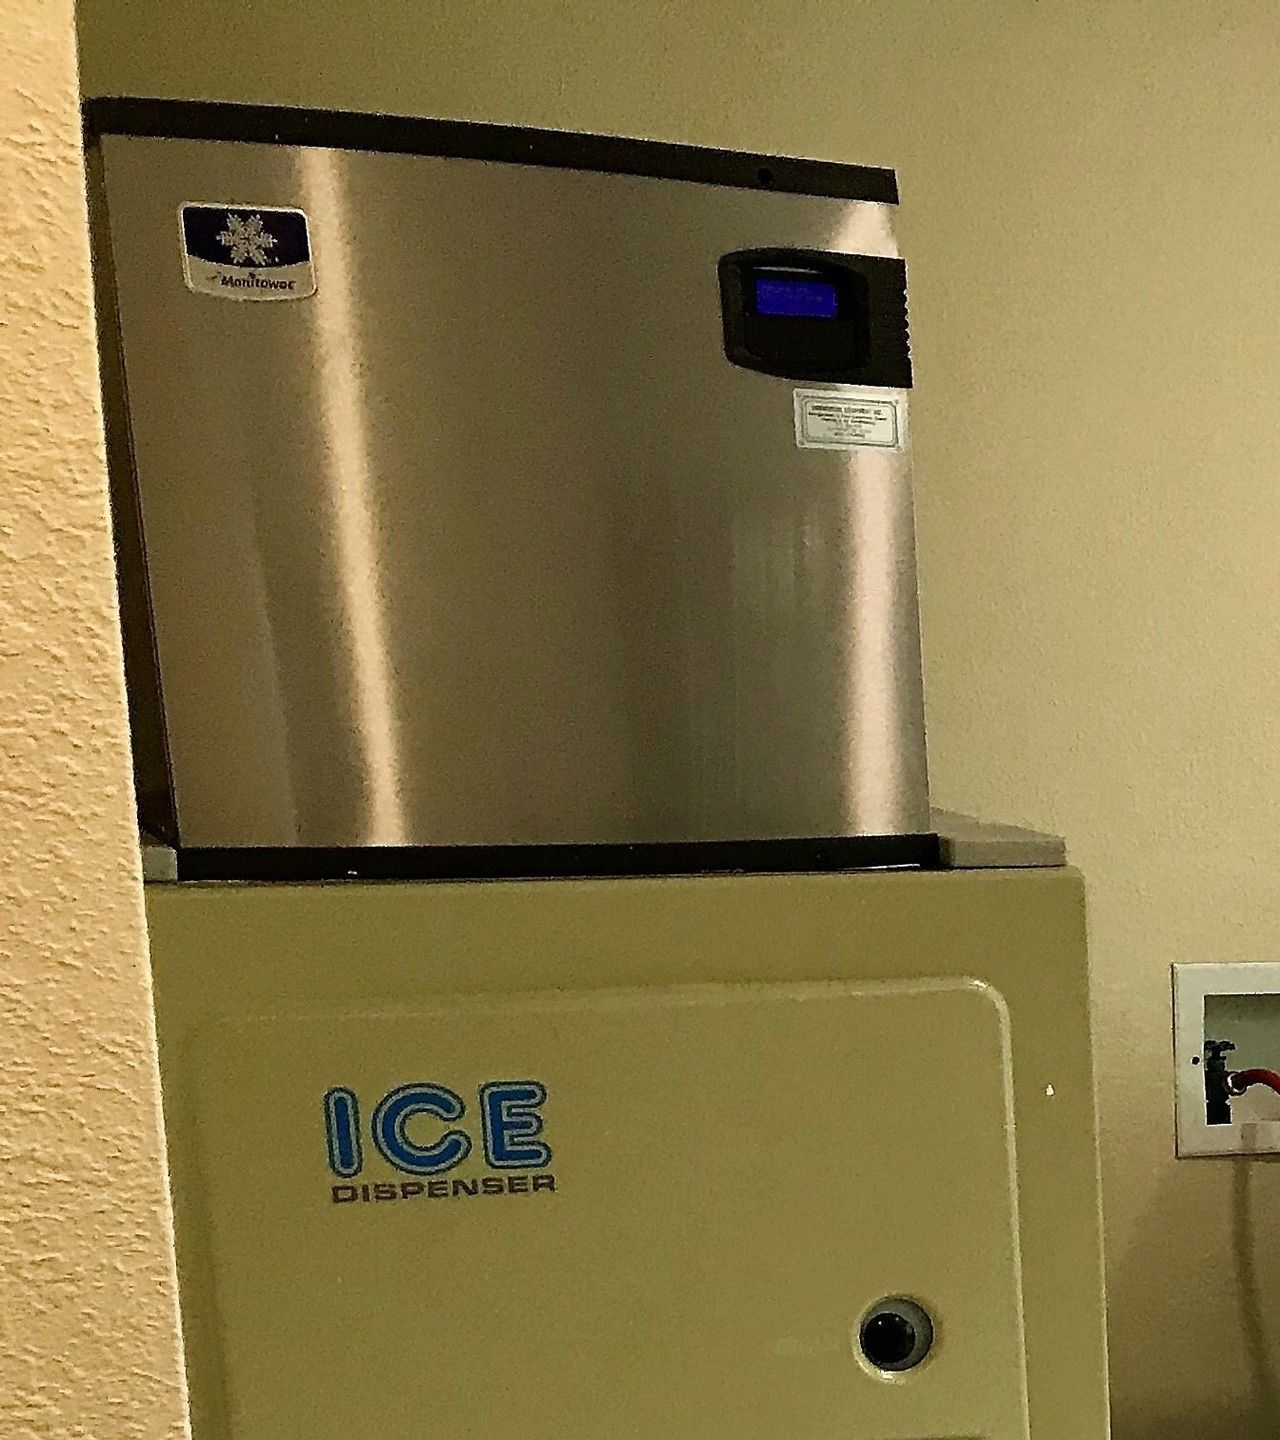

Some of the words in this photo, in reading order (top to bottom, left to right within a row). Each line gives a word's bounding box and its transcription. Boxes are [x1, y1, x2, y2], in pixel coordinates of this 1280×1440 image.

[220, 275, 297, 290] Manitowoc
[322, 1080, 554, 1179] ICE
[331, 1174, 557, 1205] DISPENSER
